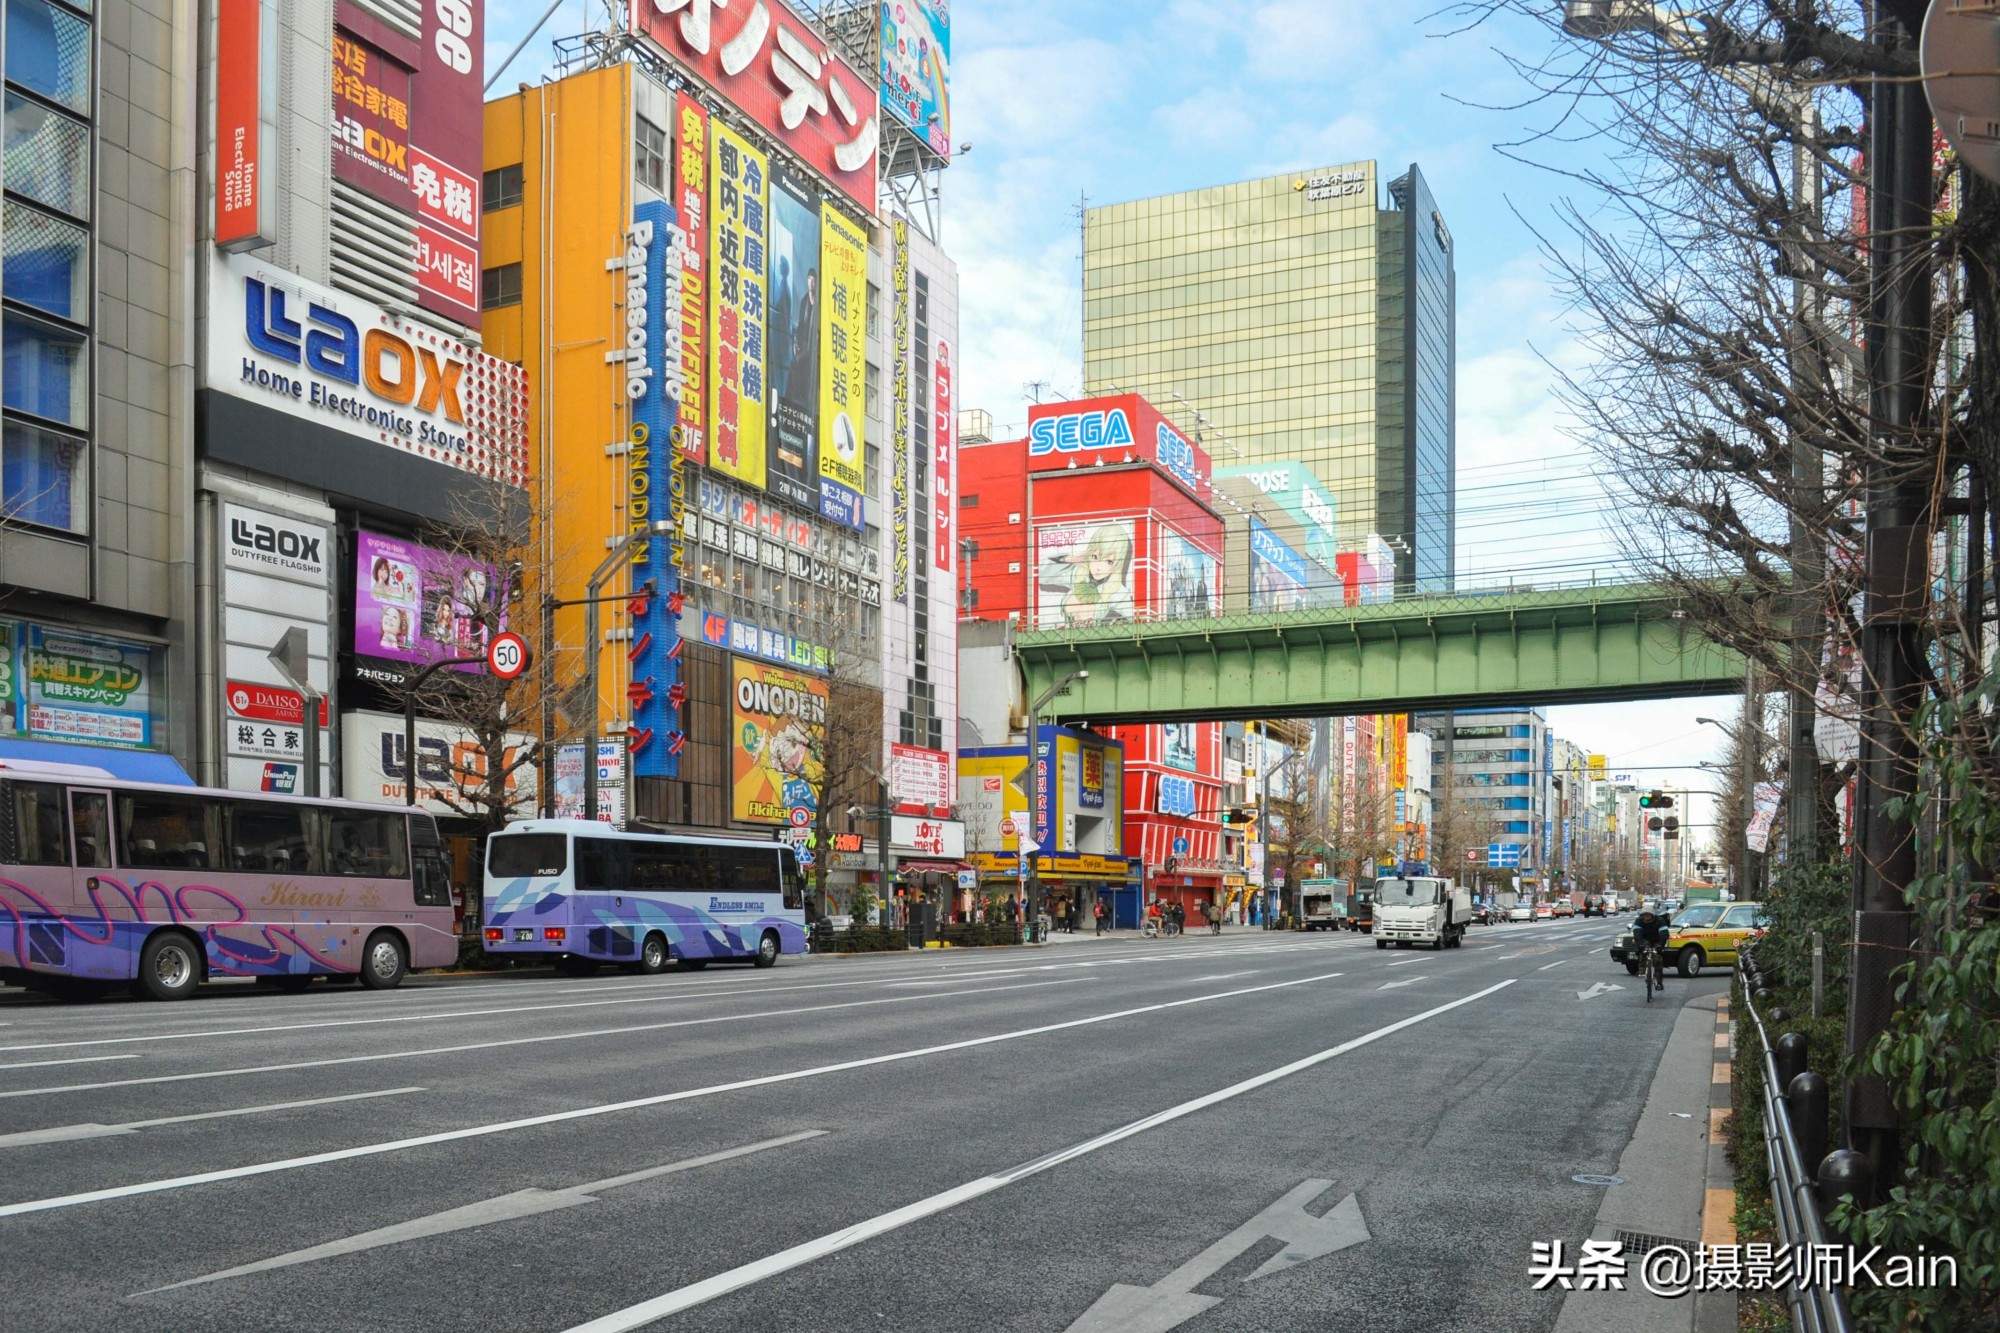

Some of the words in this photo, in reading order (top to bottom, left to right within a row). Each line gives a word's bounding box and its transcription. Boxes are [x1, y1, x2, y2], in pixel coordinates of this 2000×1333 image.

[436, 0, 473, 75] ee
[234, 127, 245, 209] Electronics
[345, 146, 387, 174] Electronics
[388, 169, 409, 185] Store
[681, 105, 704, 193] 免税
[225, 170, 234, 212] Store
[244, 162, 254, 207] Home
[411, 162, 473, 226] 免税
[825, 212, 864, 252] Panasonic
[627, 220, 653, 399] Panasonic
[665, 221, 687, 405] Panasonic
[831, 276, 848, 407] 補聴器
[241, 357, 303, 398] Home
[310, 381, 413, 437] Electronics
[420, 420, 466, 452] Store
[1030, 410, 1134, 455] SEGA
[937, 376, 949, 562] ラブメルシー
[1156, 422, 1197, 491] SEGA
[231, 518, 321, 564] Laox
[1041, 530, 1085, 541] BORDER
[231, 548, 278, 565] DUTYFREE
[281, 559, 322, 574] FLAGSHIP
[29, 653, 139, 690] 快適エアコン
[497, 645, 518, 665] 50
[789, 637, 810, 667] LED
[356, 668, 405, 683] アキバビジョン
[763, 671, 795, 689] Welcome
[256, 692, 300, 709] DAISO
[275, 709, 299, 718] JAPAN
[738, 678, 826, 723] ONODEN
[238, 725, 299, 749] 総合家
[1345, 742, 1354, 770] DUTY
[264, 770, 294, 780] UnionPay
[1085, 751, 1101, 787] 薬
[1160, 775, 1195, 816] SEGA
[916, 822, 942, 838] LOVE
[1020, 862, 1027, 874] P
